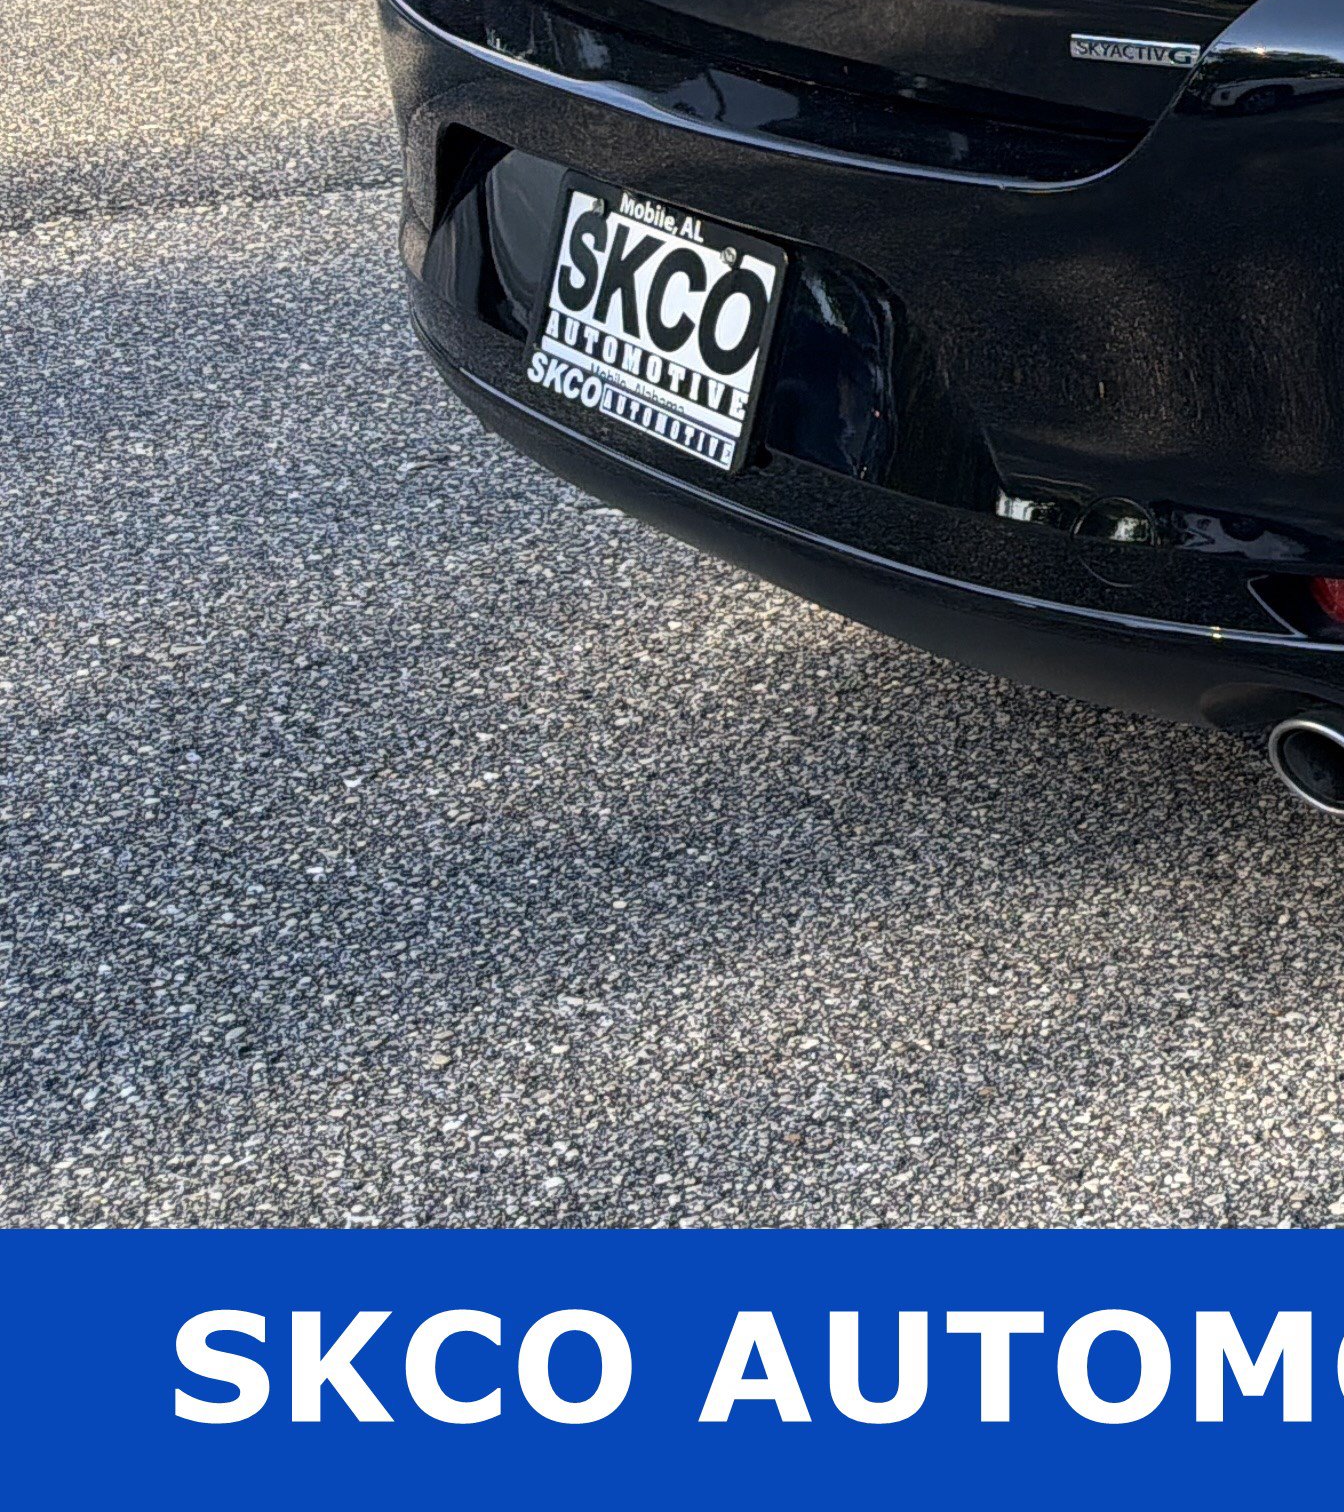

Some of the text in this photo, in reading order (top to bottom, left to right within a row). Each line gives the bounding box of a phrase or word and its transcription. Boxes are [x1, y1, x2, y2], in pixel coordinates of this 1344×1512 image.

[619, 191, 705, 243] Mobile, AL
[557, 209, 770, 376] SKCO
[526, 351, 733, 464] SKCO AUTOMOTIVE
[546, 309, 751, 421] AUTOMOTIVE
